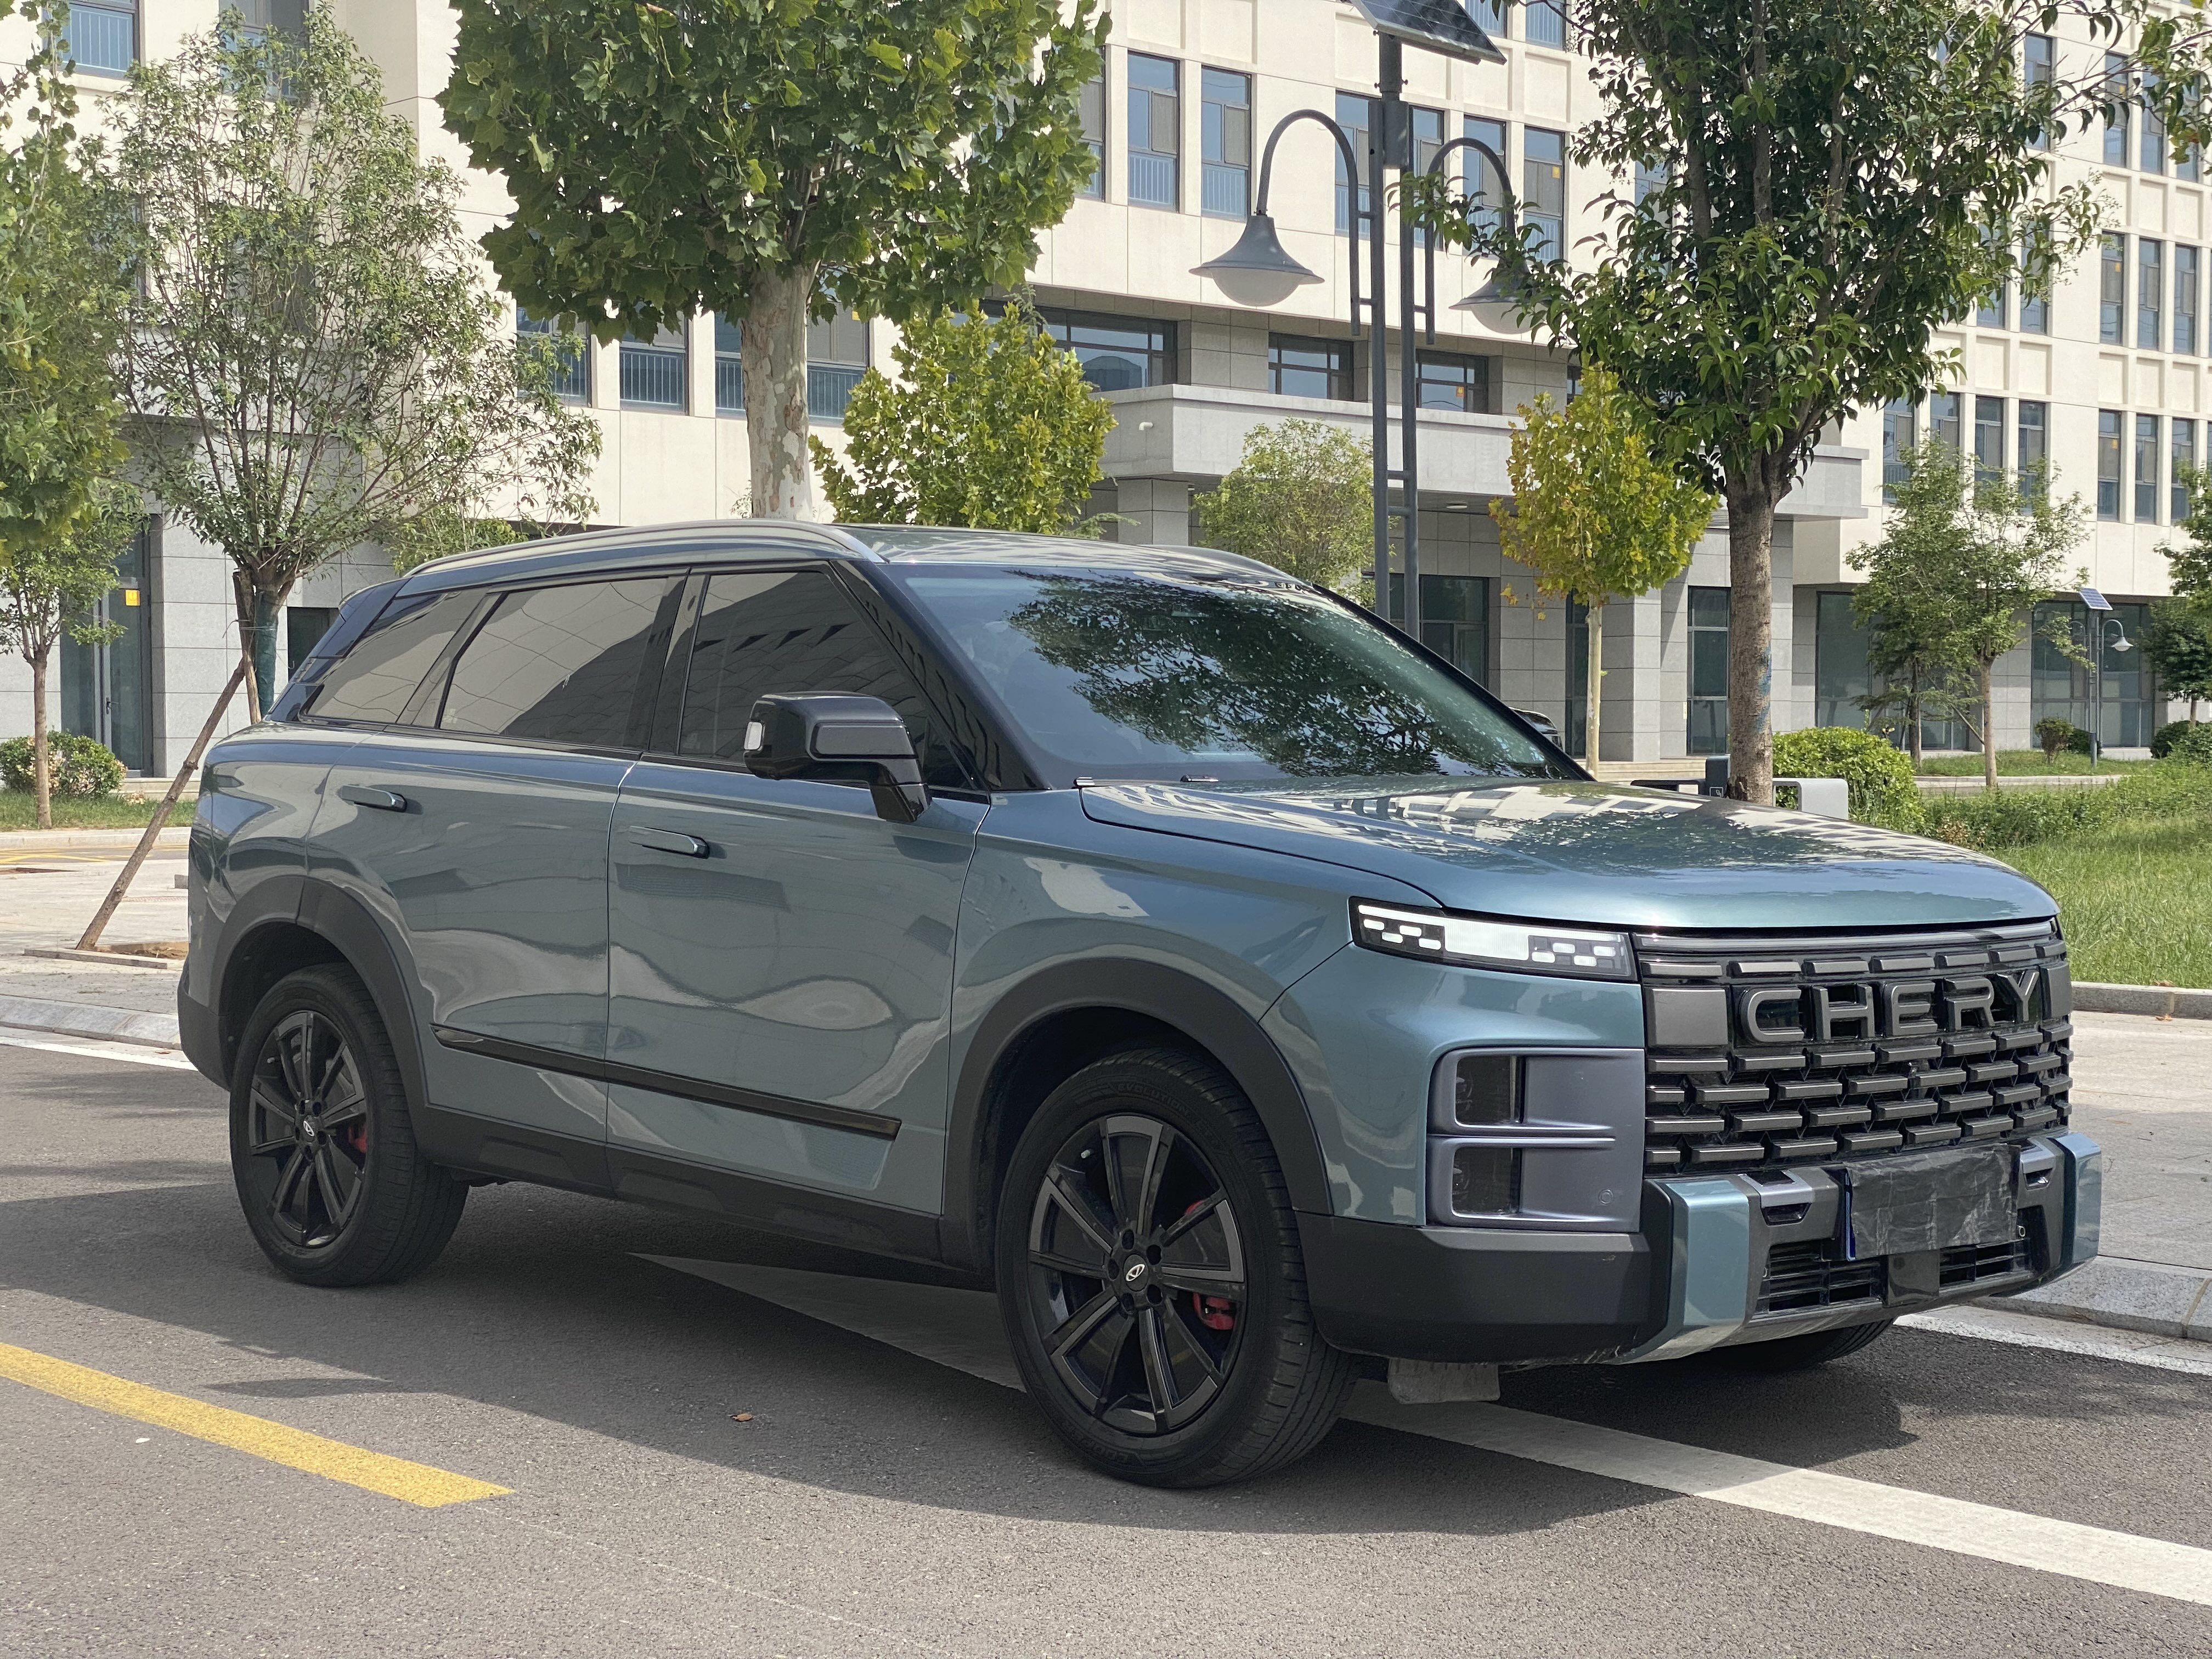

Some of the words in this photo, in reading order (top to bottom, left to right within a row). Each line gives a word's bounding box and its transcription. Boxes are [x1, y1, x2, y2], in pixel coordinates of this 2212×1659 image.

[1741, 969, 2040, 1042] CHERY
[1118, 1082, 1189, 1116] EVOLUTION
[1060, 1419, 1128, 1463] COOPER
